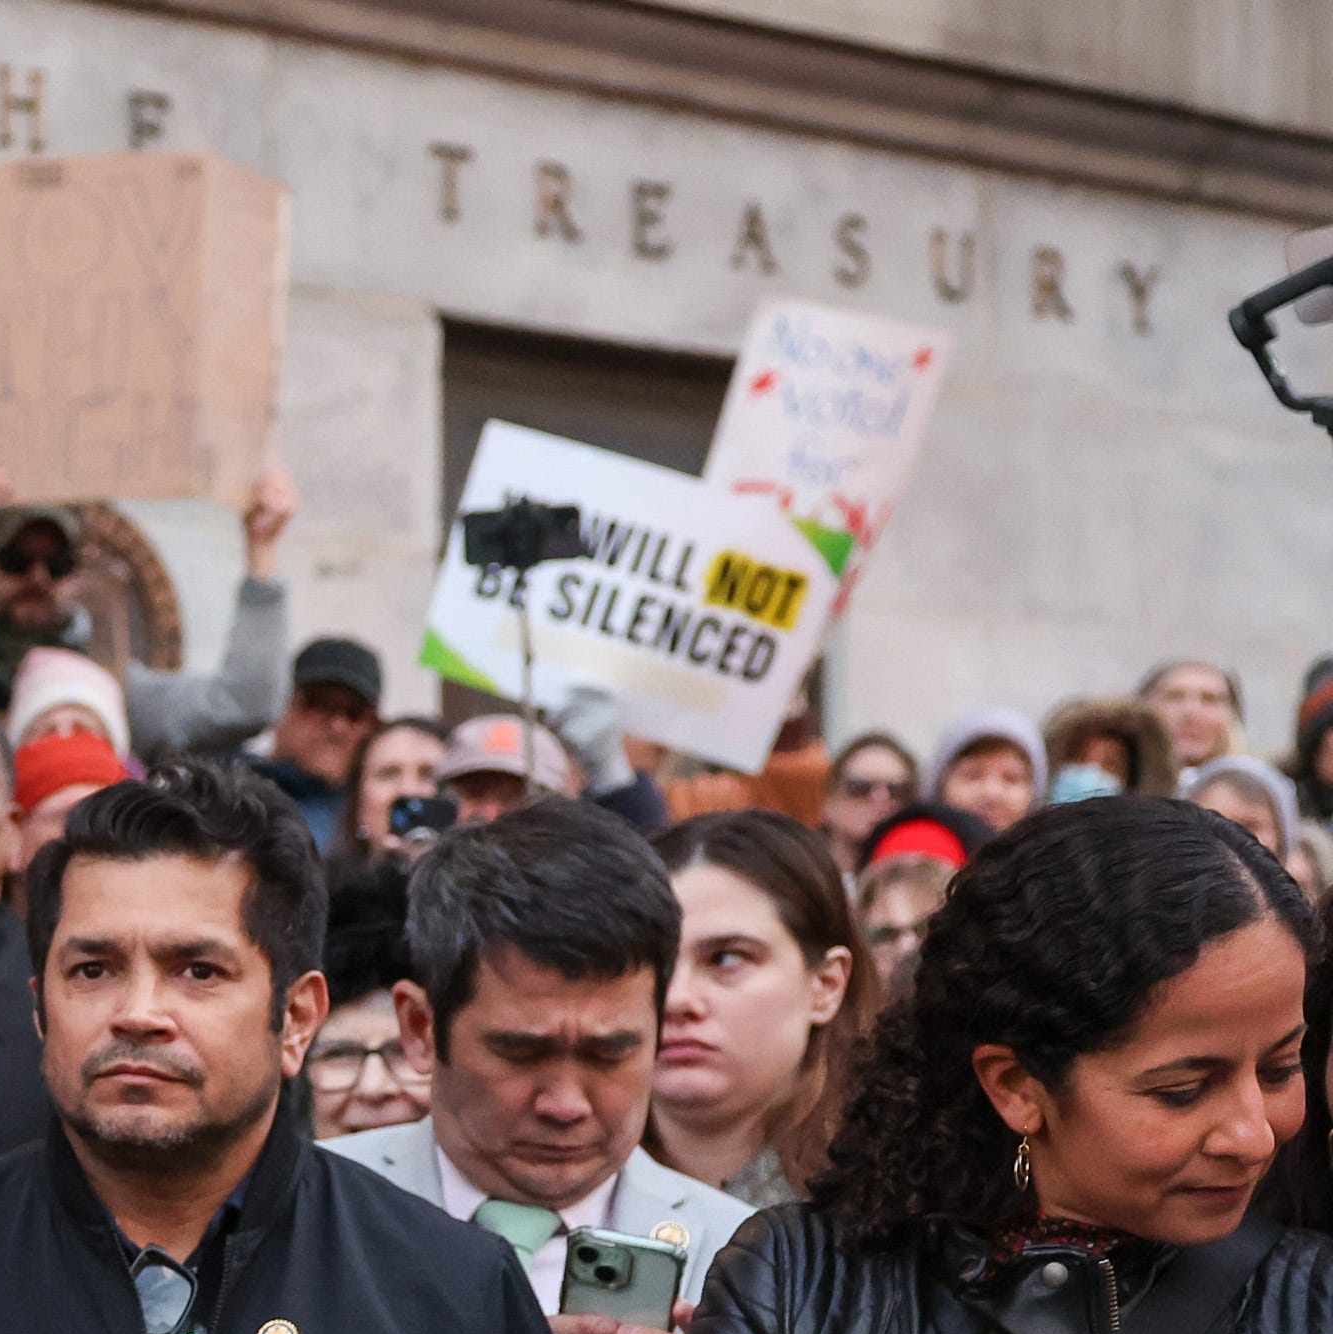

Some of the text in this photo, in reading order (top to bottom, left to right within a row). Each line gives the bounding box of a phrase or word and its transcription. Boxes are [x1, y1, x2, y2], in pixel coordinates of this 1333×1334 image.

[429, 142, 1165, 336] TREASURY
[581, 513, 696, 591] WILL
[717, 557, 805, 623] NOT
[547, 571, 777, 681] SILENCED
